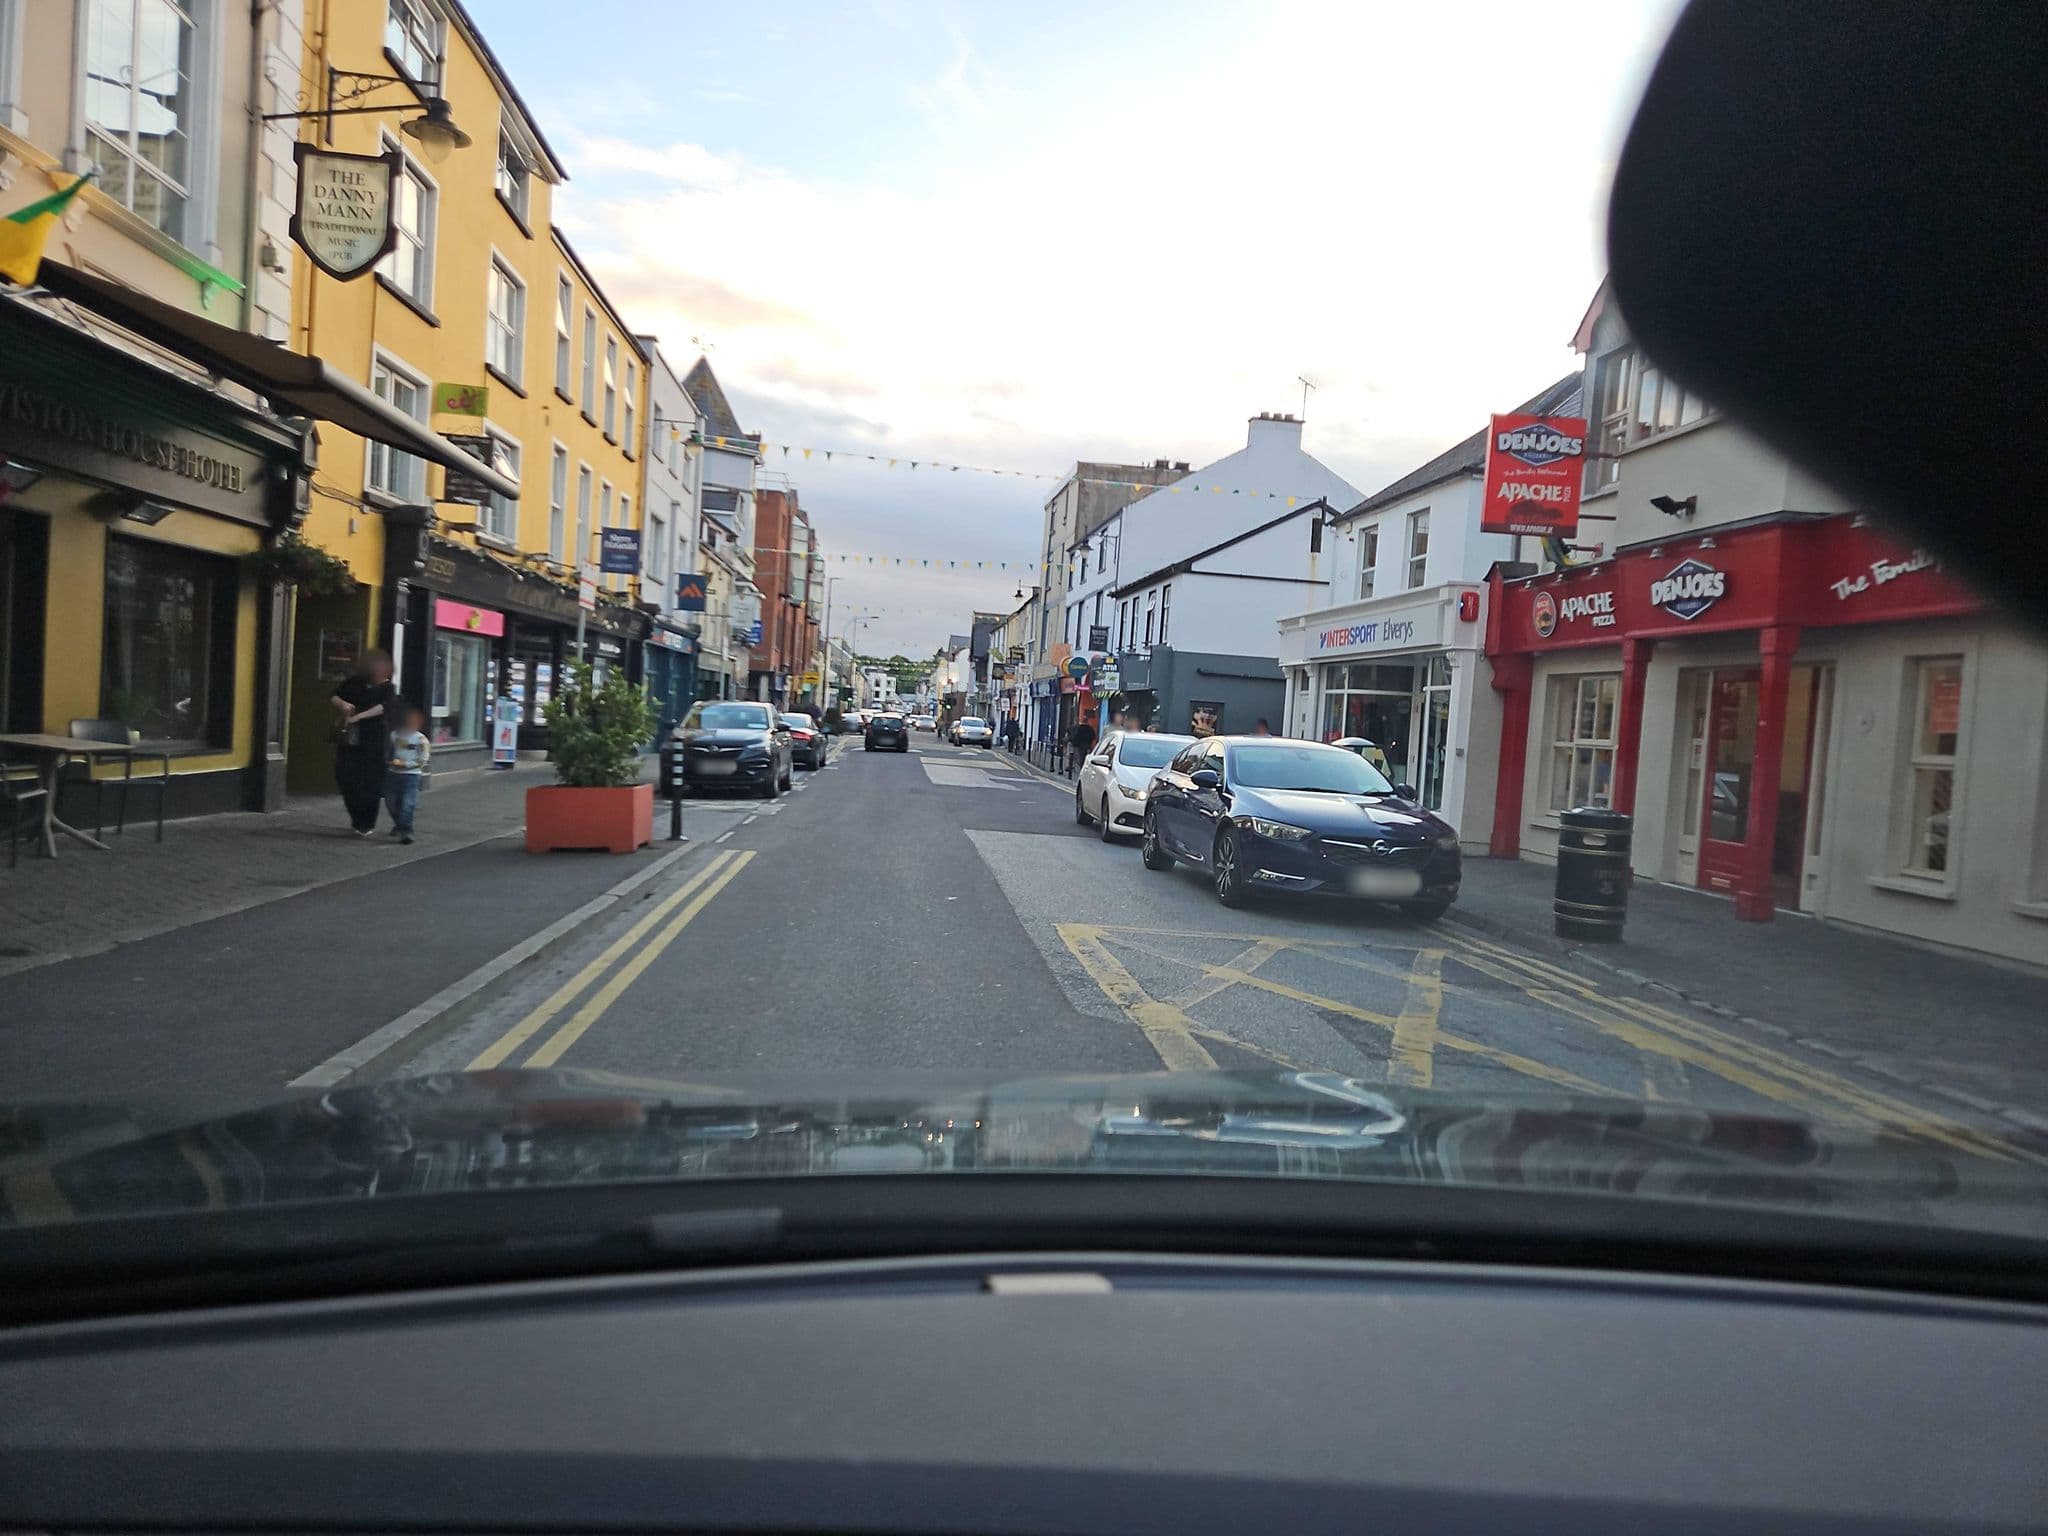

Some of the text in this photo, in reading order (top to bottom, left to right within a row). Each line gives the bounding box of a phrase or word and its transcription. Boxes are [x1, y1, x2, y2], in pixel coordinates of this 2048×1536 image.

[328, 169, 366, 186] THE
[314, 185, 378, 204] DANNY
[318, 202, 373, 220] MANN
[310, 221, 377, 235] TRADITIONAL
[328, 237, 360, 248] MUSIC
[333, 251, 353, 261] PUB
[1498, 432, 1582, 455] DENJOES
[102, 421, 177, 471] HOUSE
[182, 447, 247, 494] HOTEL
[1497, 482, 1563, 502] APACHE
[1651, 572, 1725, 606] DENJOES
[1830, 576, 1870, 600] The
[1560, 591, 1616, 622] APACHE
[1592, 615, 1616, 627] PIZZA
[1326, 618, 1414, 648] INTERSPORT Elverys
